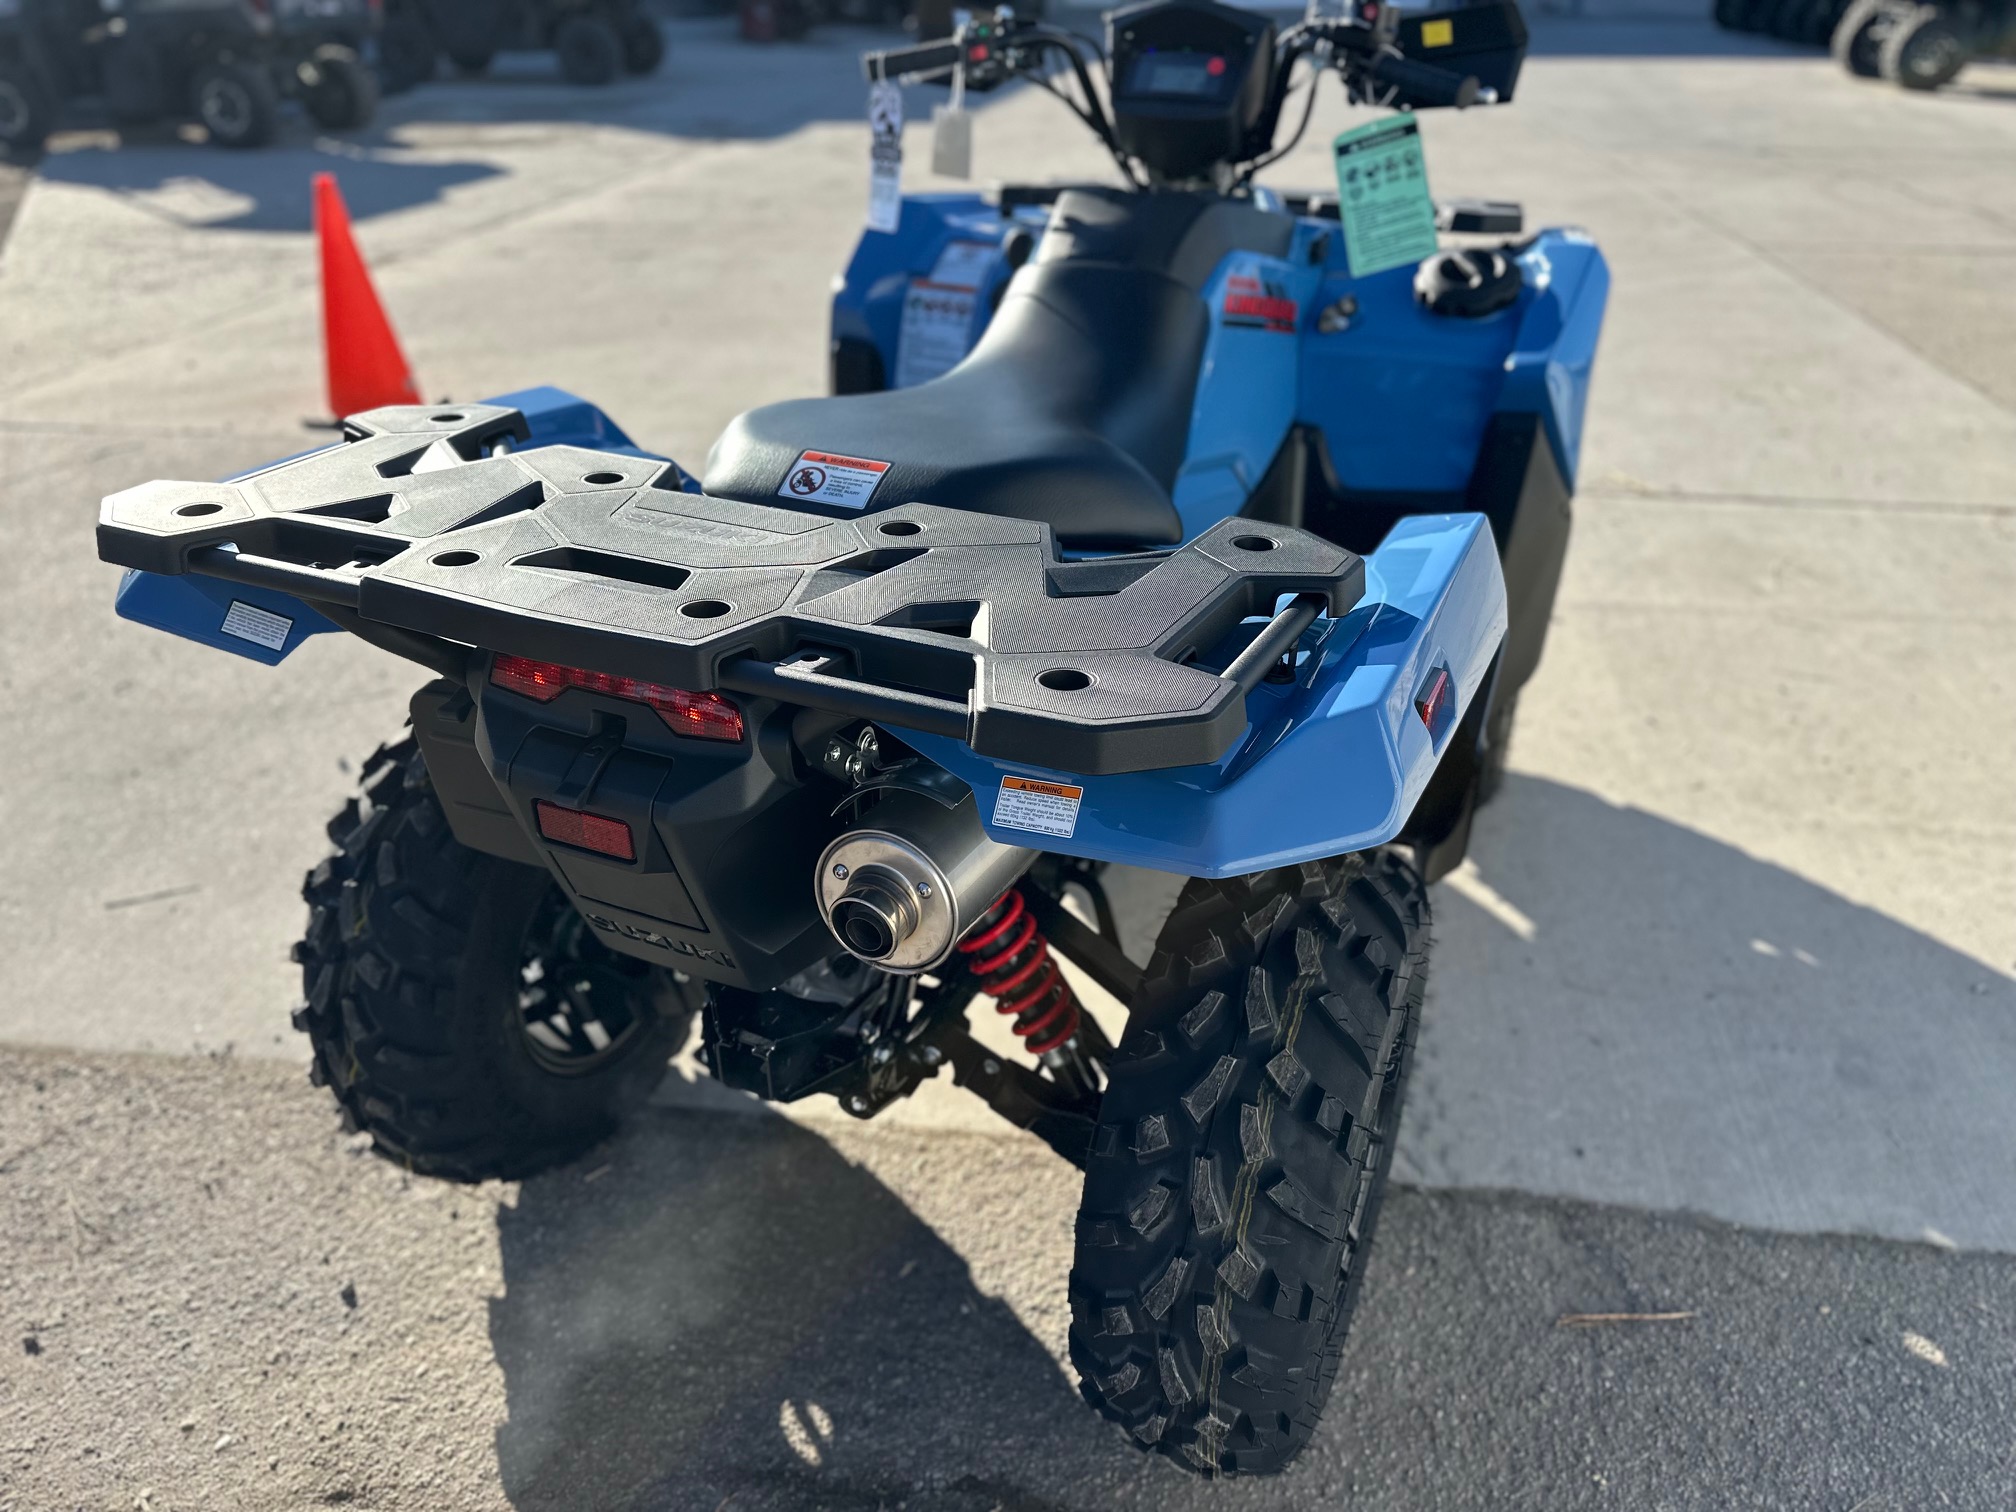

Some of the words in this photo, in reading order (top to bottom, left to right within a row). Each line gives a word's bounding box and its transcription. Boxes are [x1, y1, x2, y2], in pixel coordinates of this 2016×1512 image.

[830, 457, 870, 468] WARNING
[1030, 784, 1062, 794] WARNING
[586, 913, 736, 969] SUZUKI
